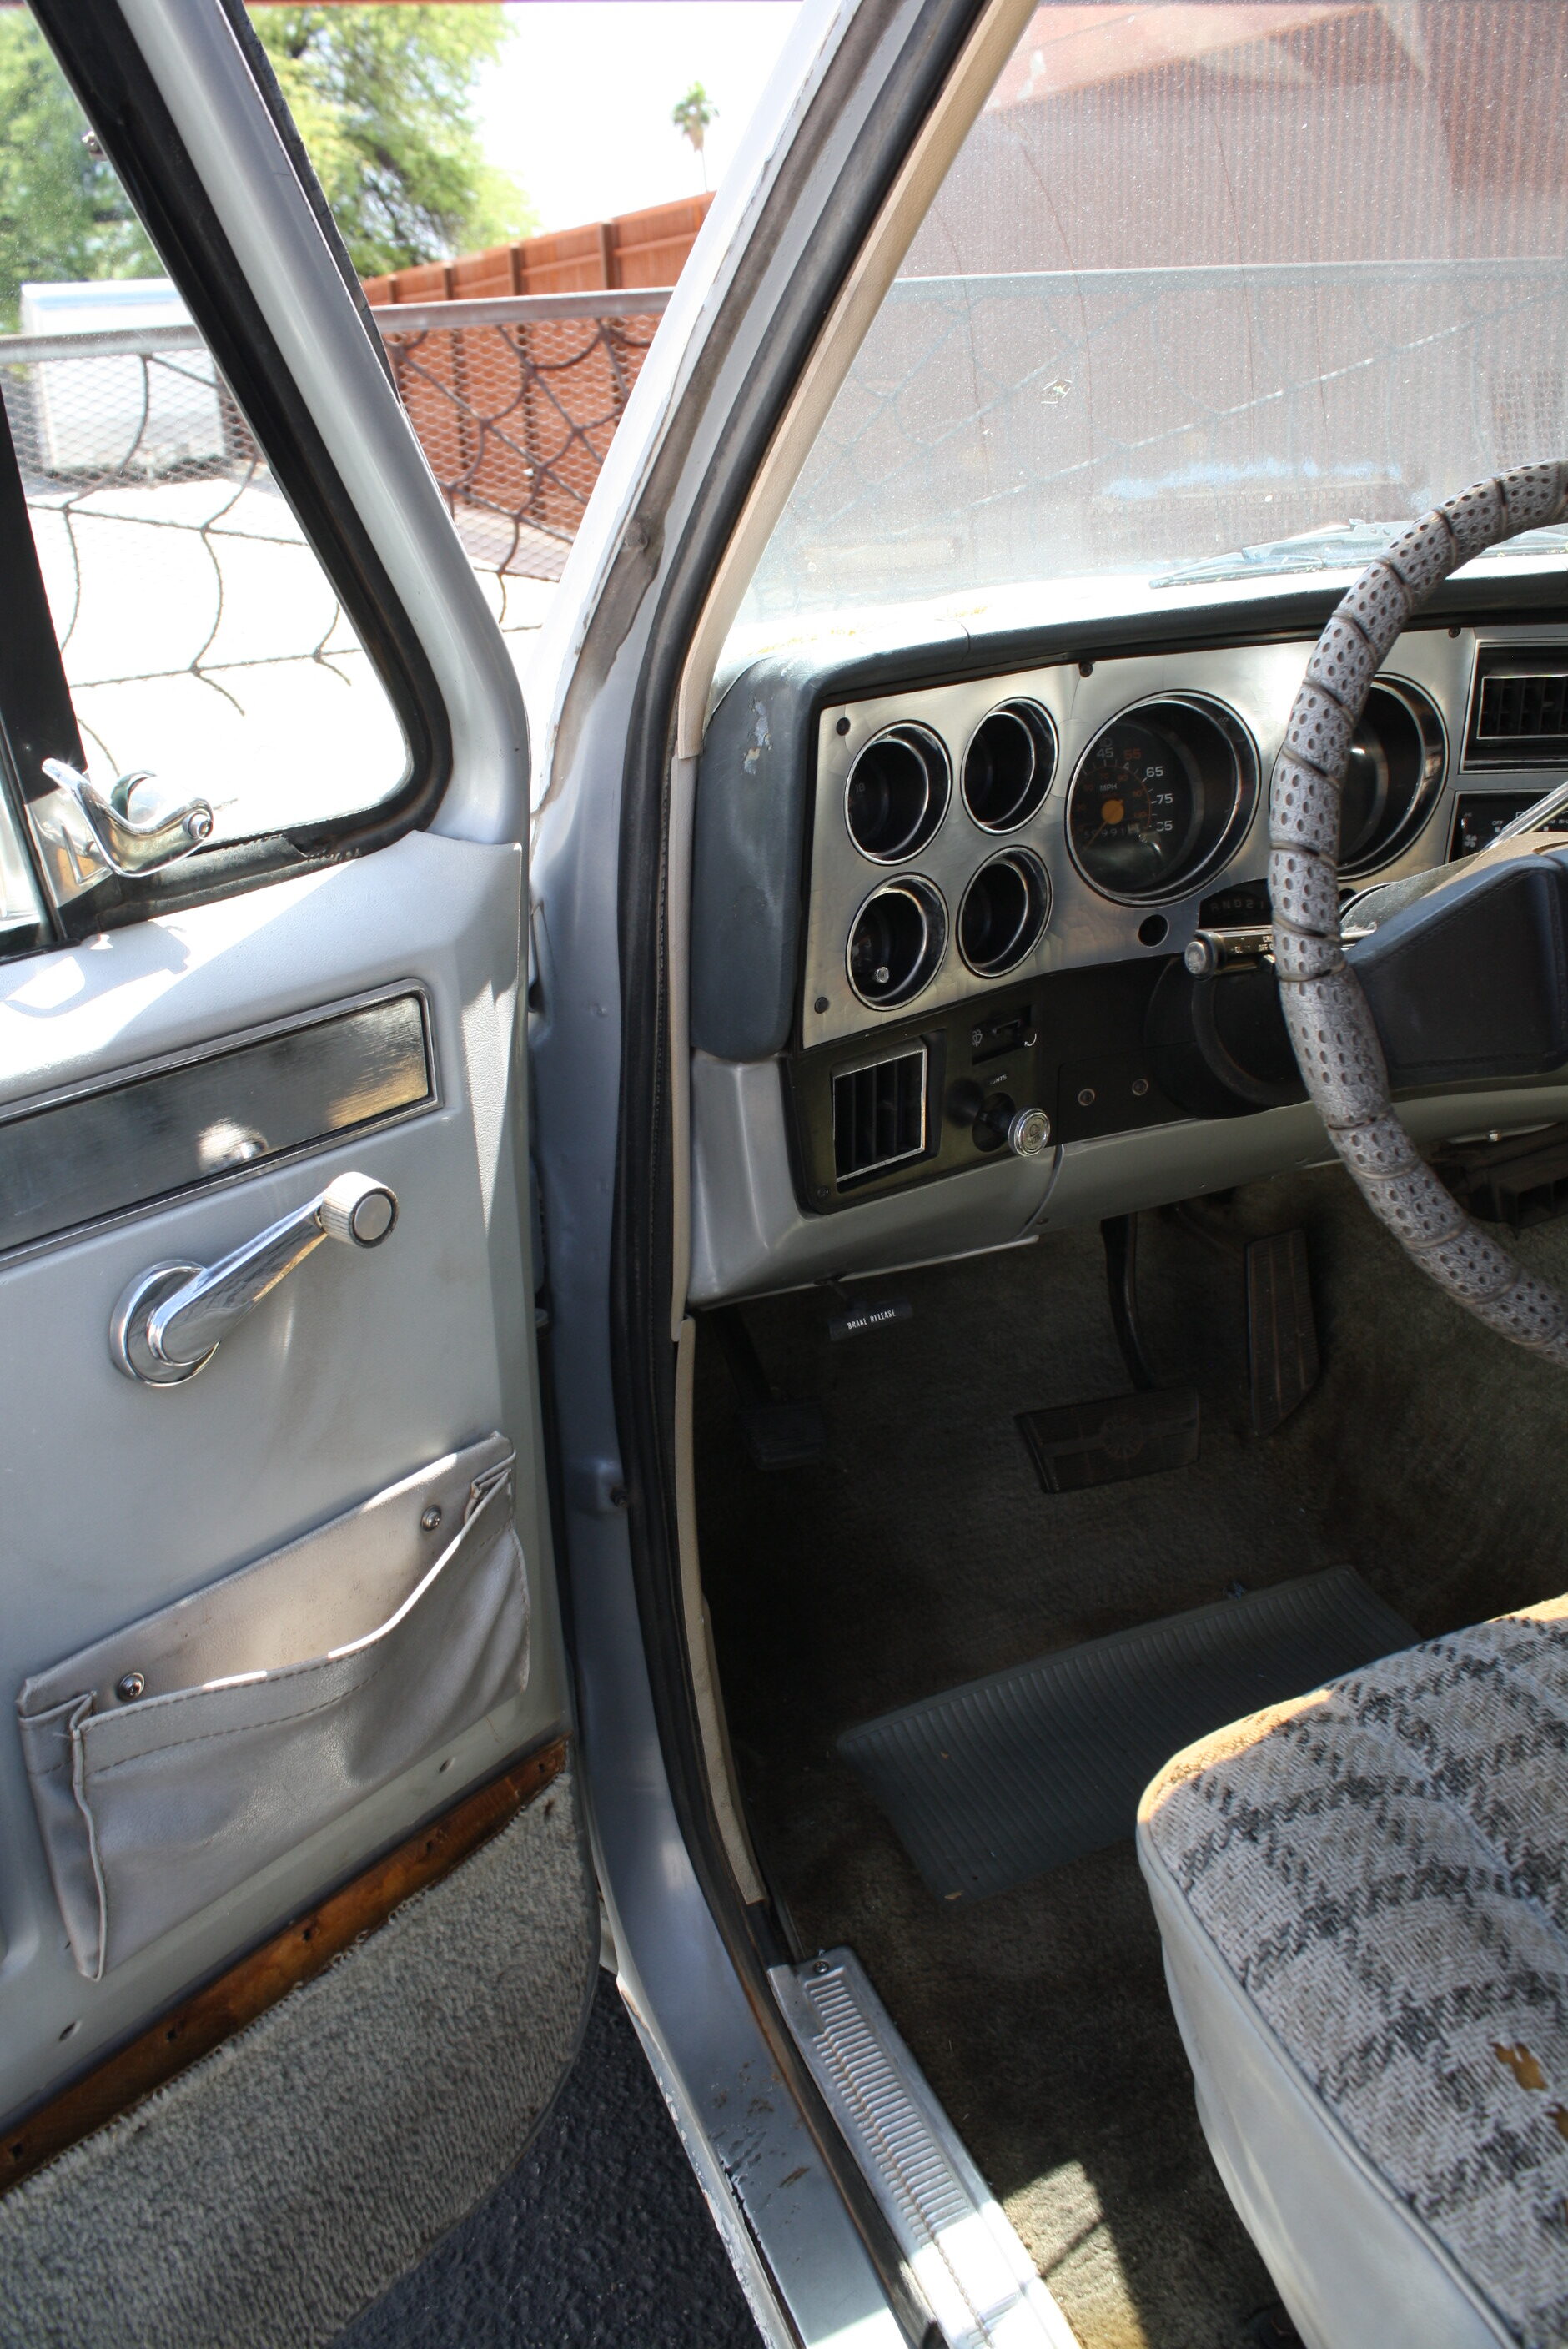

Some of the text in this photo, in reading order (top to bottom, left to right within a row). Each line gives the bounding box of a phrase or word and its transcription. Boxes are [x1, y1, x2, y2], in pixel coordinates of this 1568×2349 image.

[1097, 747, 1113, 758] 45
[1124, 748, 1141, 760] 55
[1146, 767, 1163, 777] 65
[1100, 783, 1117, 792] MPH
[1157, 794, 1173, 804] 75
[847, 1309, 897, 1330] BRAKE RELEASE
